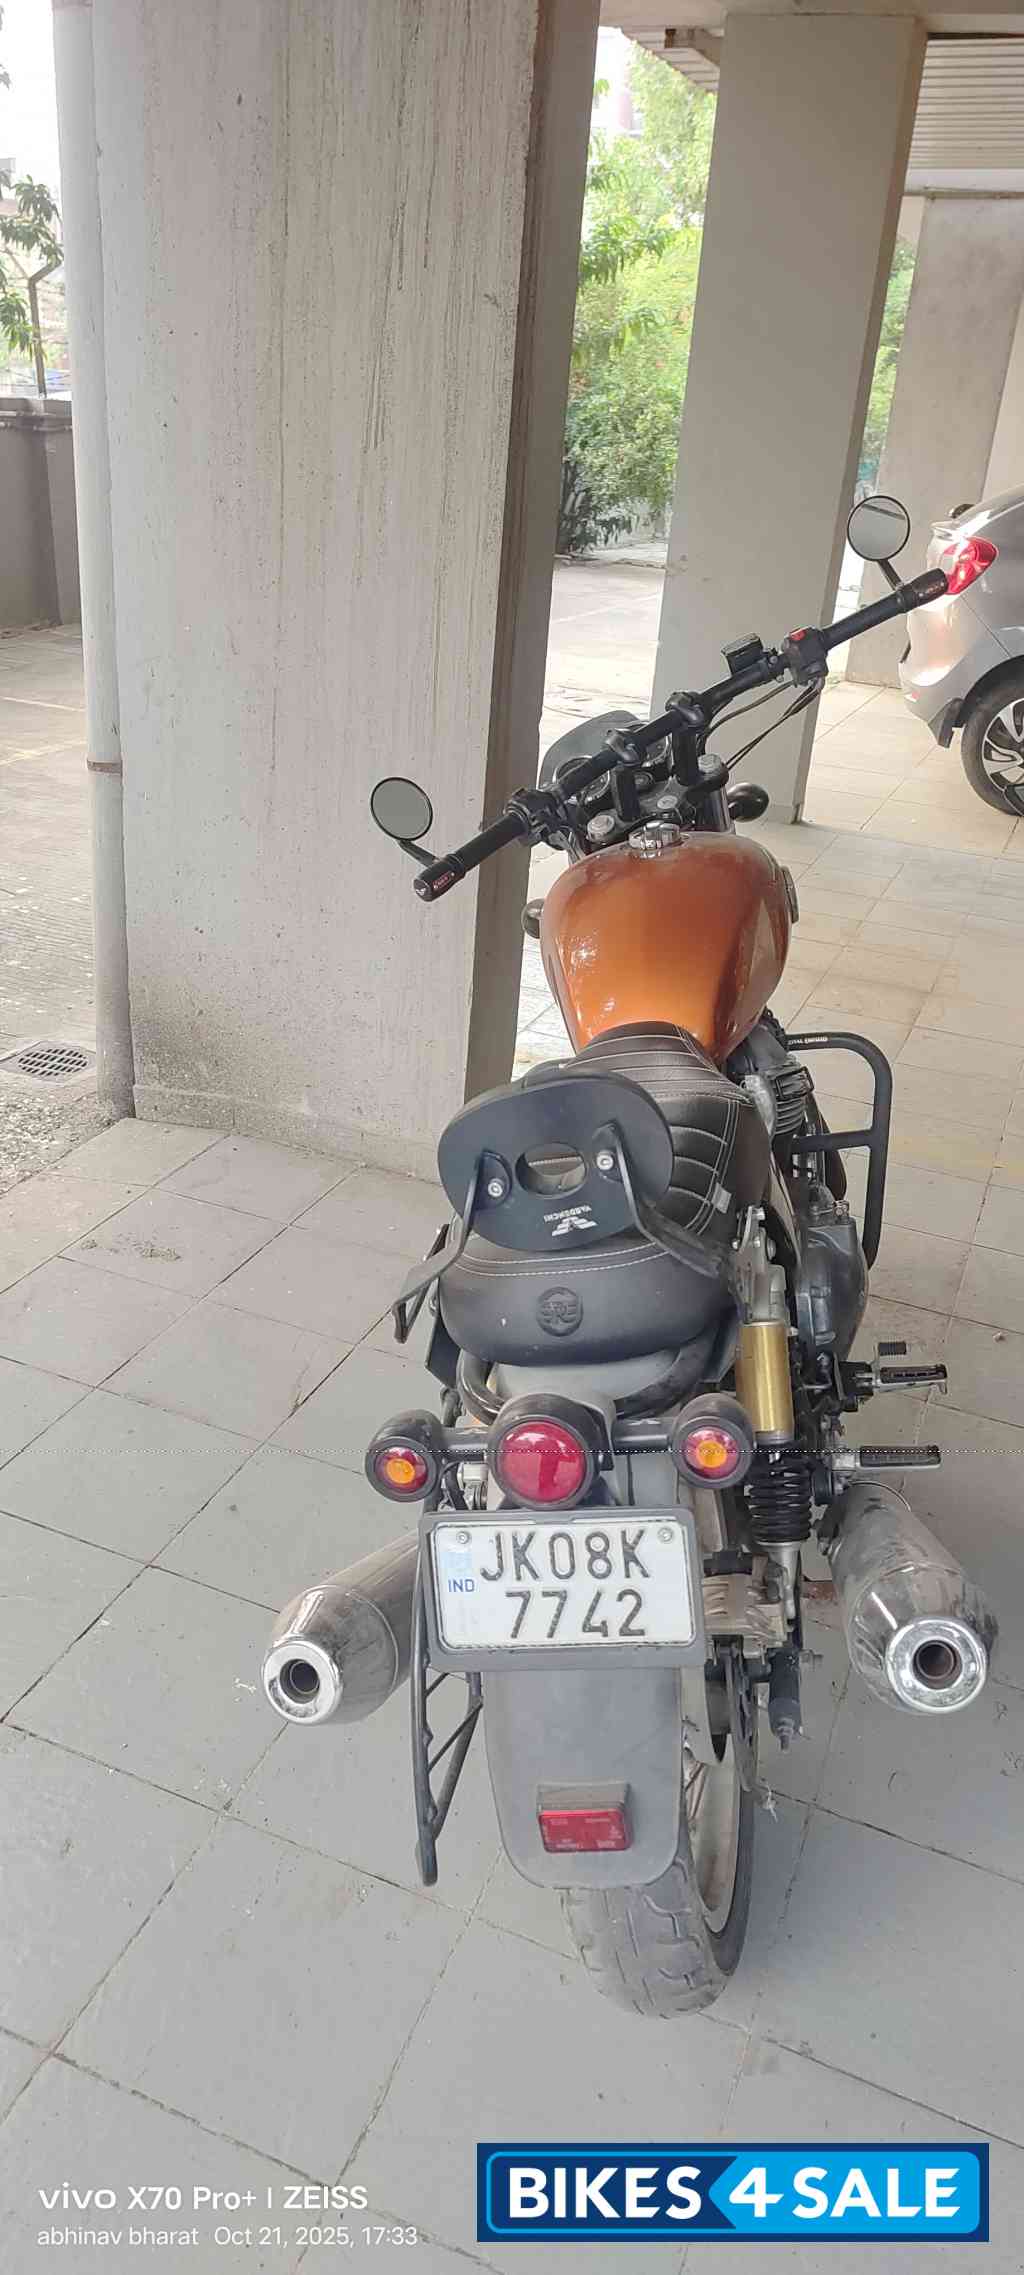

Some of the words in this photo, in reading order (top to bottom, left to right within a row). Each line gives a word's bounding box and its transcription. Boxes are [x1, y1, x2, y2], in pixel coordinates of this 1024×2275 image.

[480, 1529, 650, 1582] JK08K
[448, 1579, 475, 1593] IND
[505, 1588, 646, 1638] 7742
